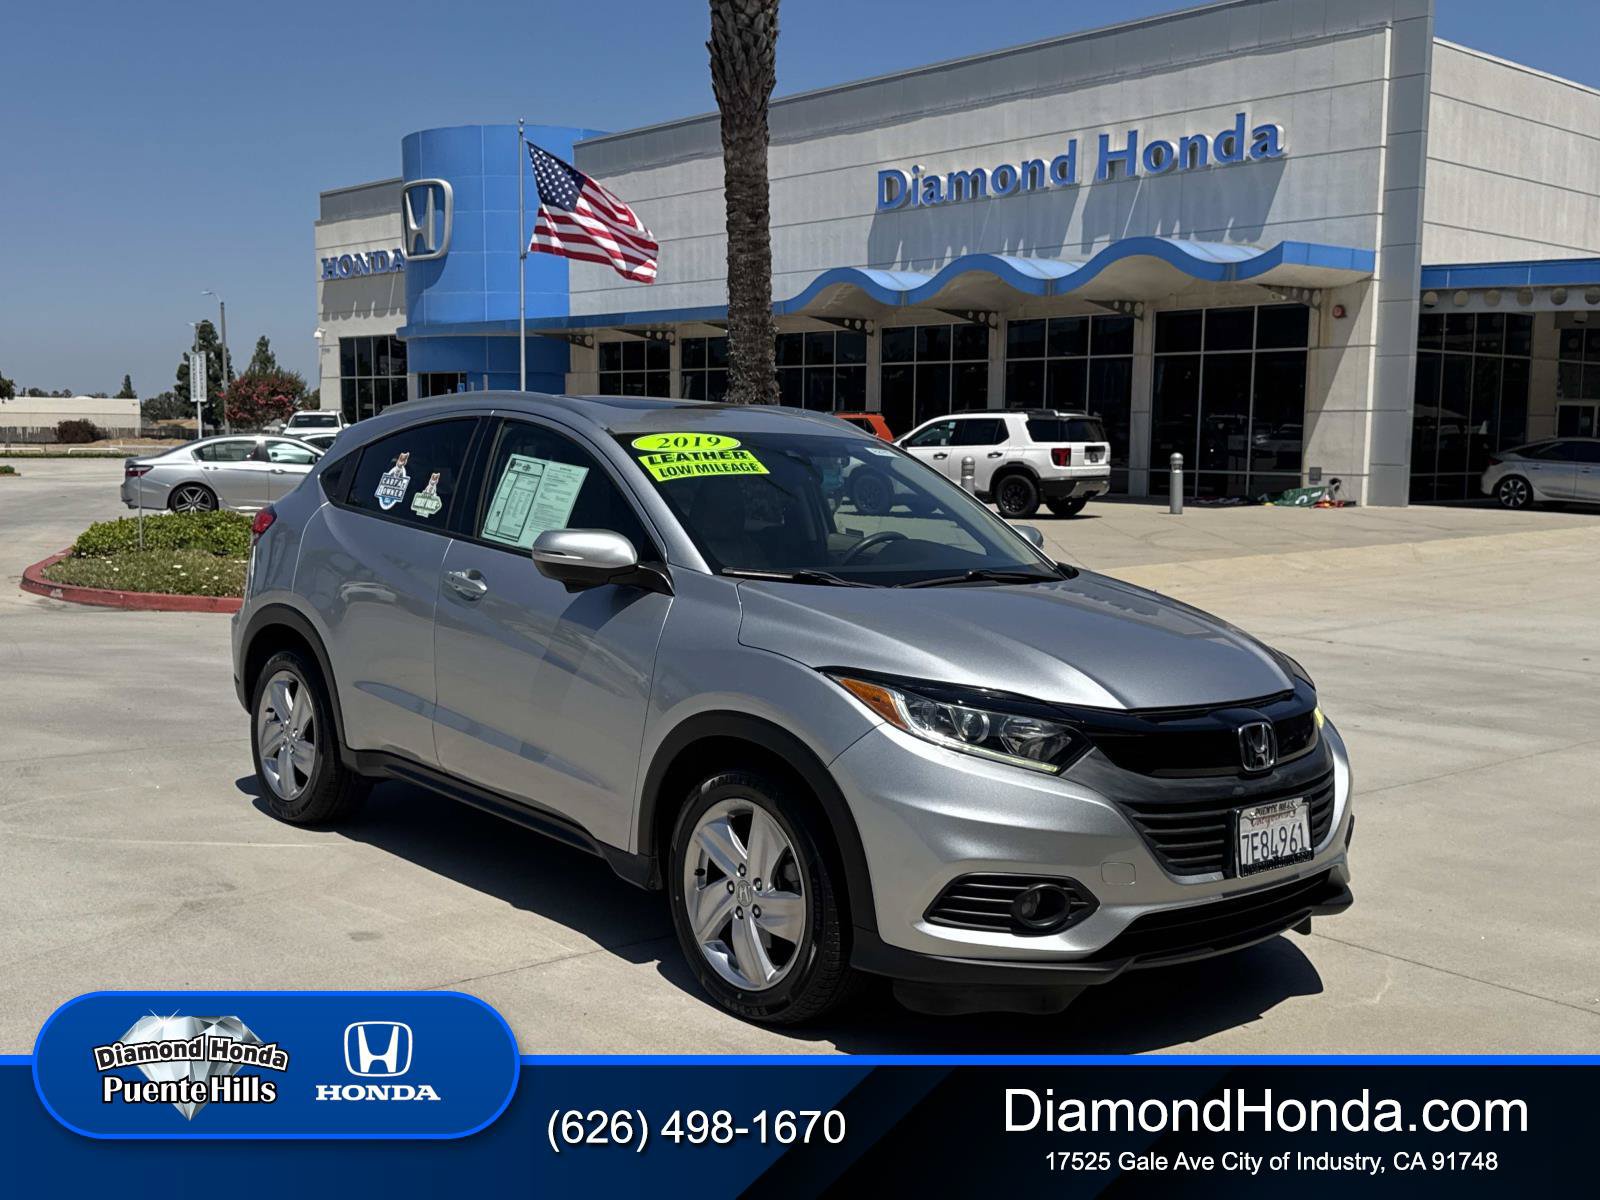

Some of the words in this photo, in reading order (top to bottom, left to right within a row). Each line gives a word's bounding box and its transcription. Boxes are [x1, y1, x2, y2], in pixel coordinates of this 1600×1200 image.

[877, 138, 1079, 211] Diamond
[1099, 112, 1285, 180] Honda
[321, 247, 405, 280] HONDA
[657, 436, 721, 449] 2019
[647, 450, 748, 465] LEATHER
[658, 465, 692, 477] LOW
[695, 463, 759, 475] MILEAGE
[1241, 822, 1307, 864] 7E84961
